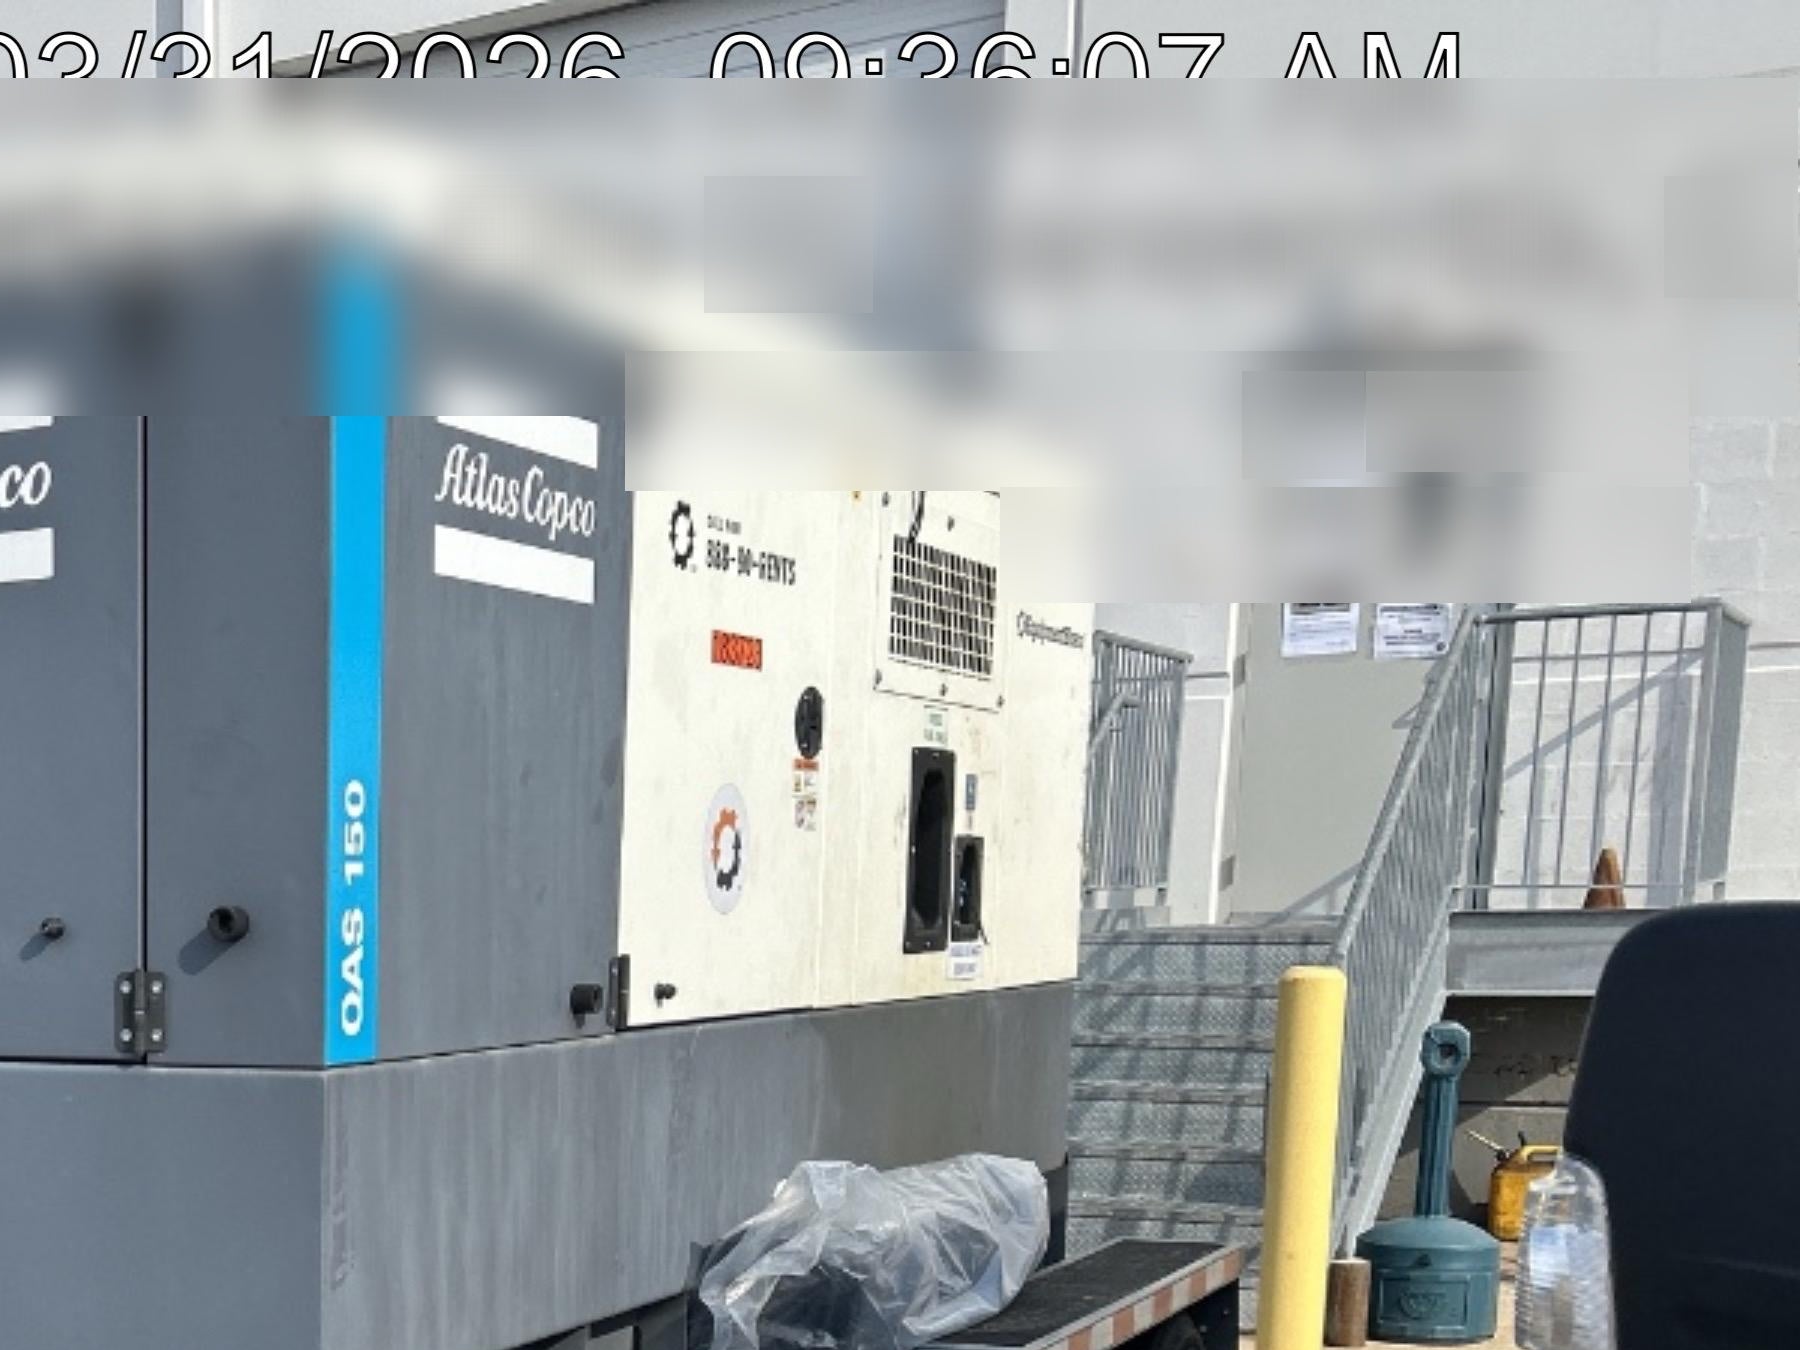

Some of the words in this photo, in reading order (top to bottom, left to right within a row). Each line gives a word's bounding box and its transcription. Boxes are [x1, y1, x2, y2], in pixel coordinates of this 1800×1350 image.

[434, 442, 520, 519] Atlas
[522, 464, 596, 541] Copco
[343, 779, 366, 887] 150
